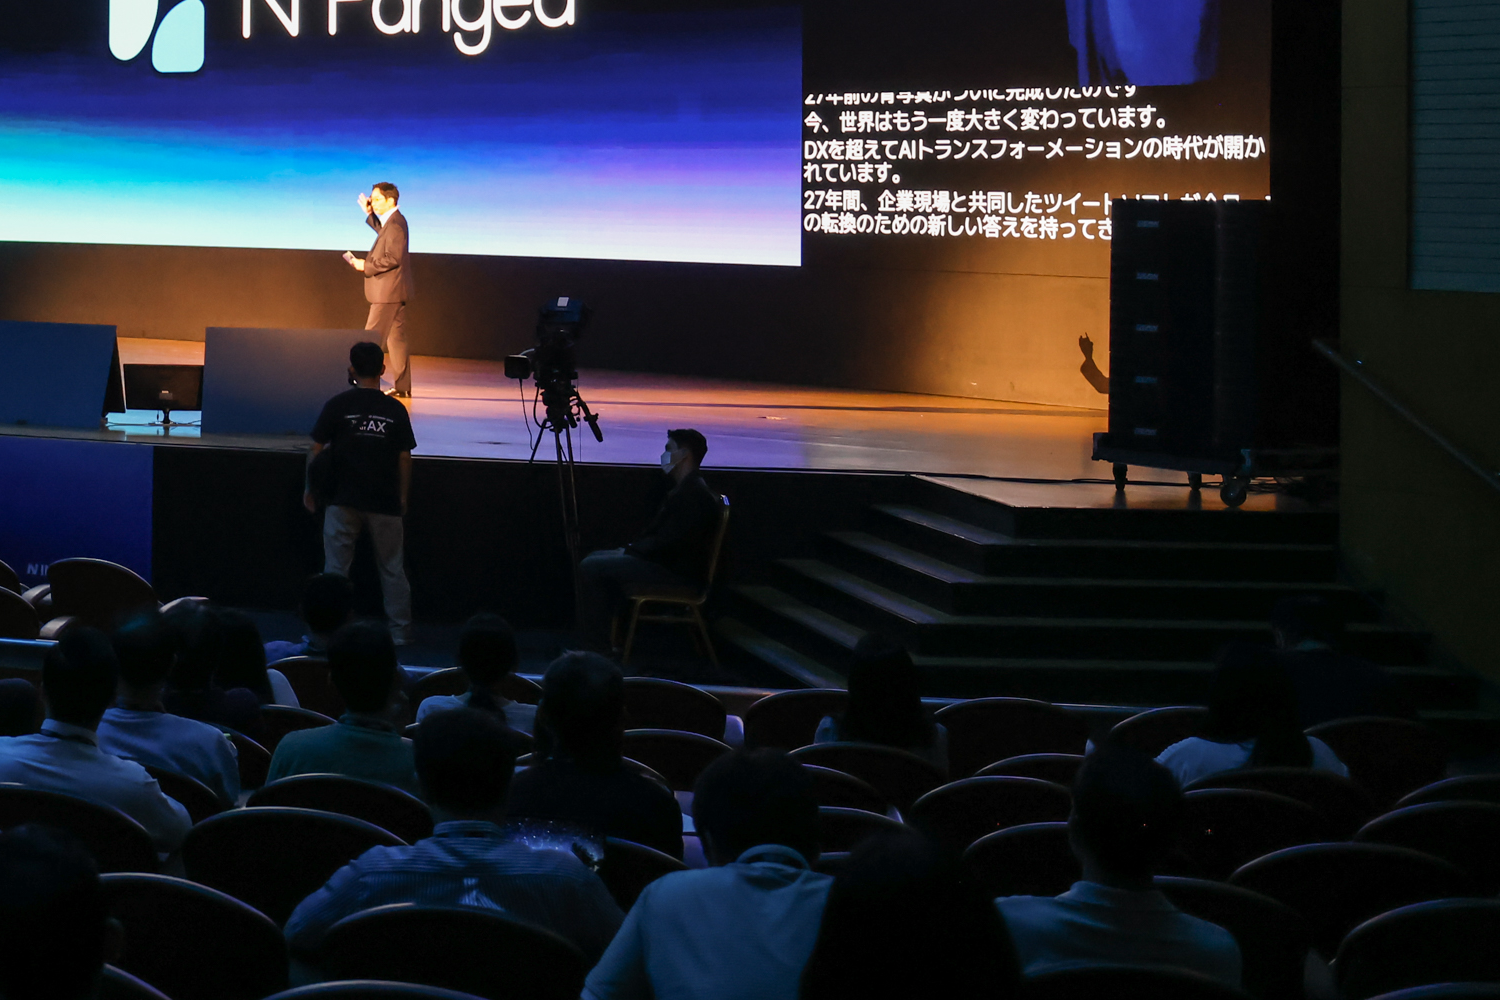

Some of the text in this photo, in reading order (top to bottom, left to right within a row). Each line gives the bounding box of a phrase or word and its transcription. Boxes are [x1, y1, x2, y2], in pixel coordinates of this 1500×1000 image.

[803, 105, 1166, 134] 今、世界はもう一度大きく変わっています。
[803, 162, 901, 184] れています。
